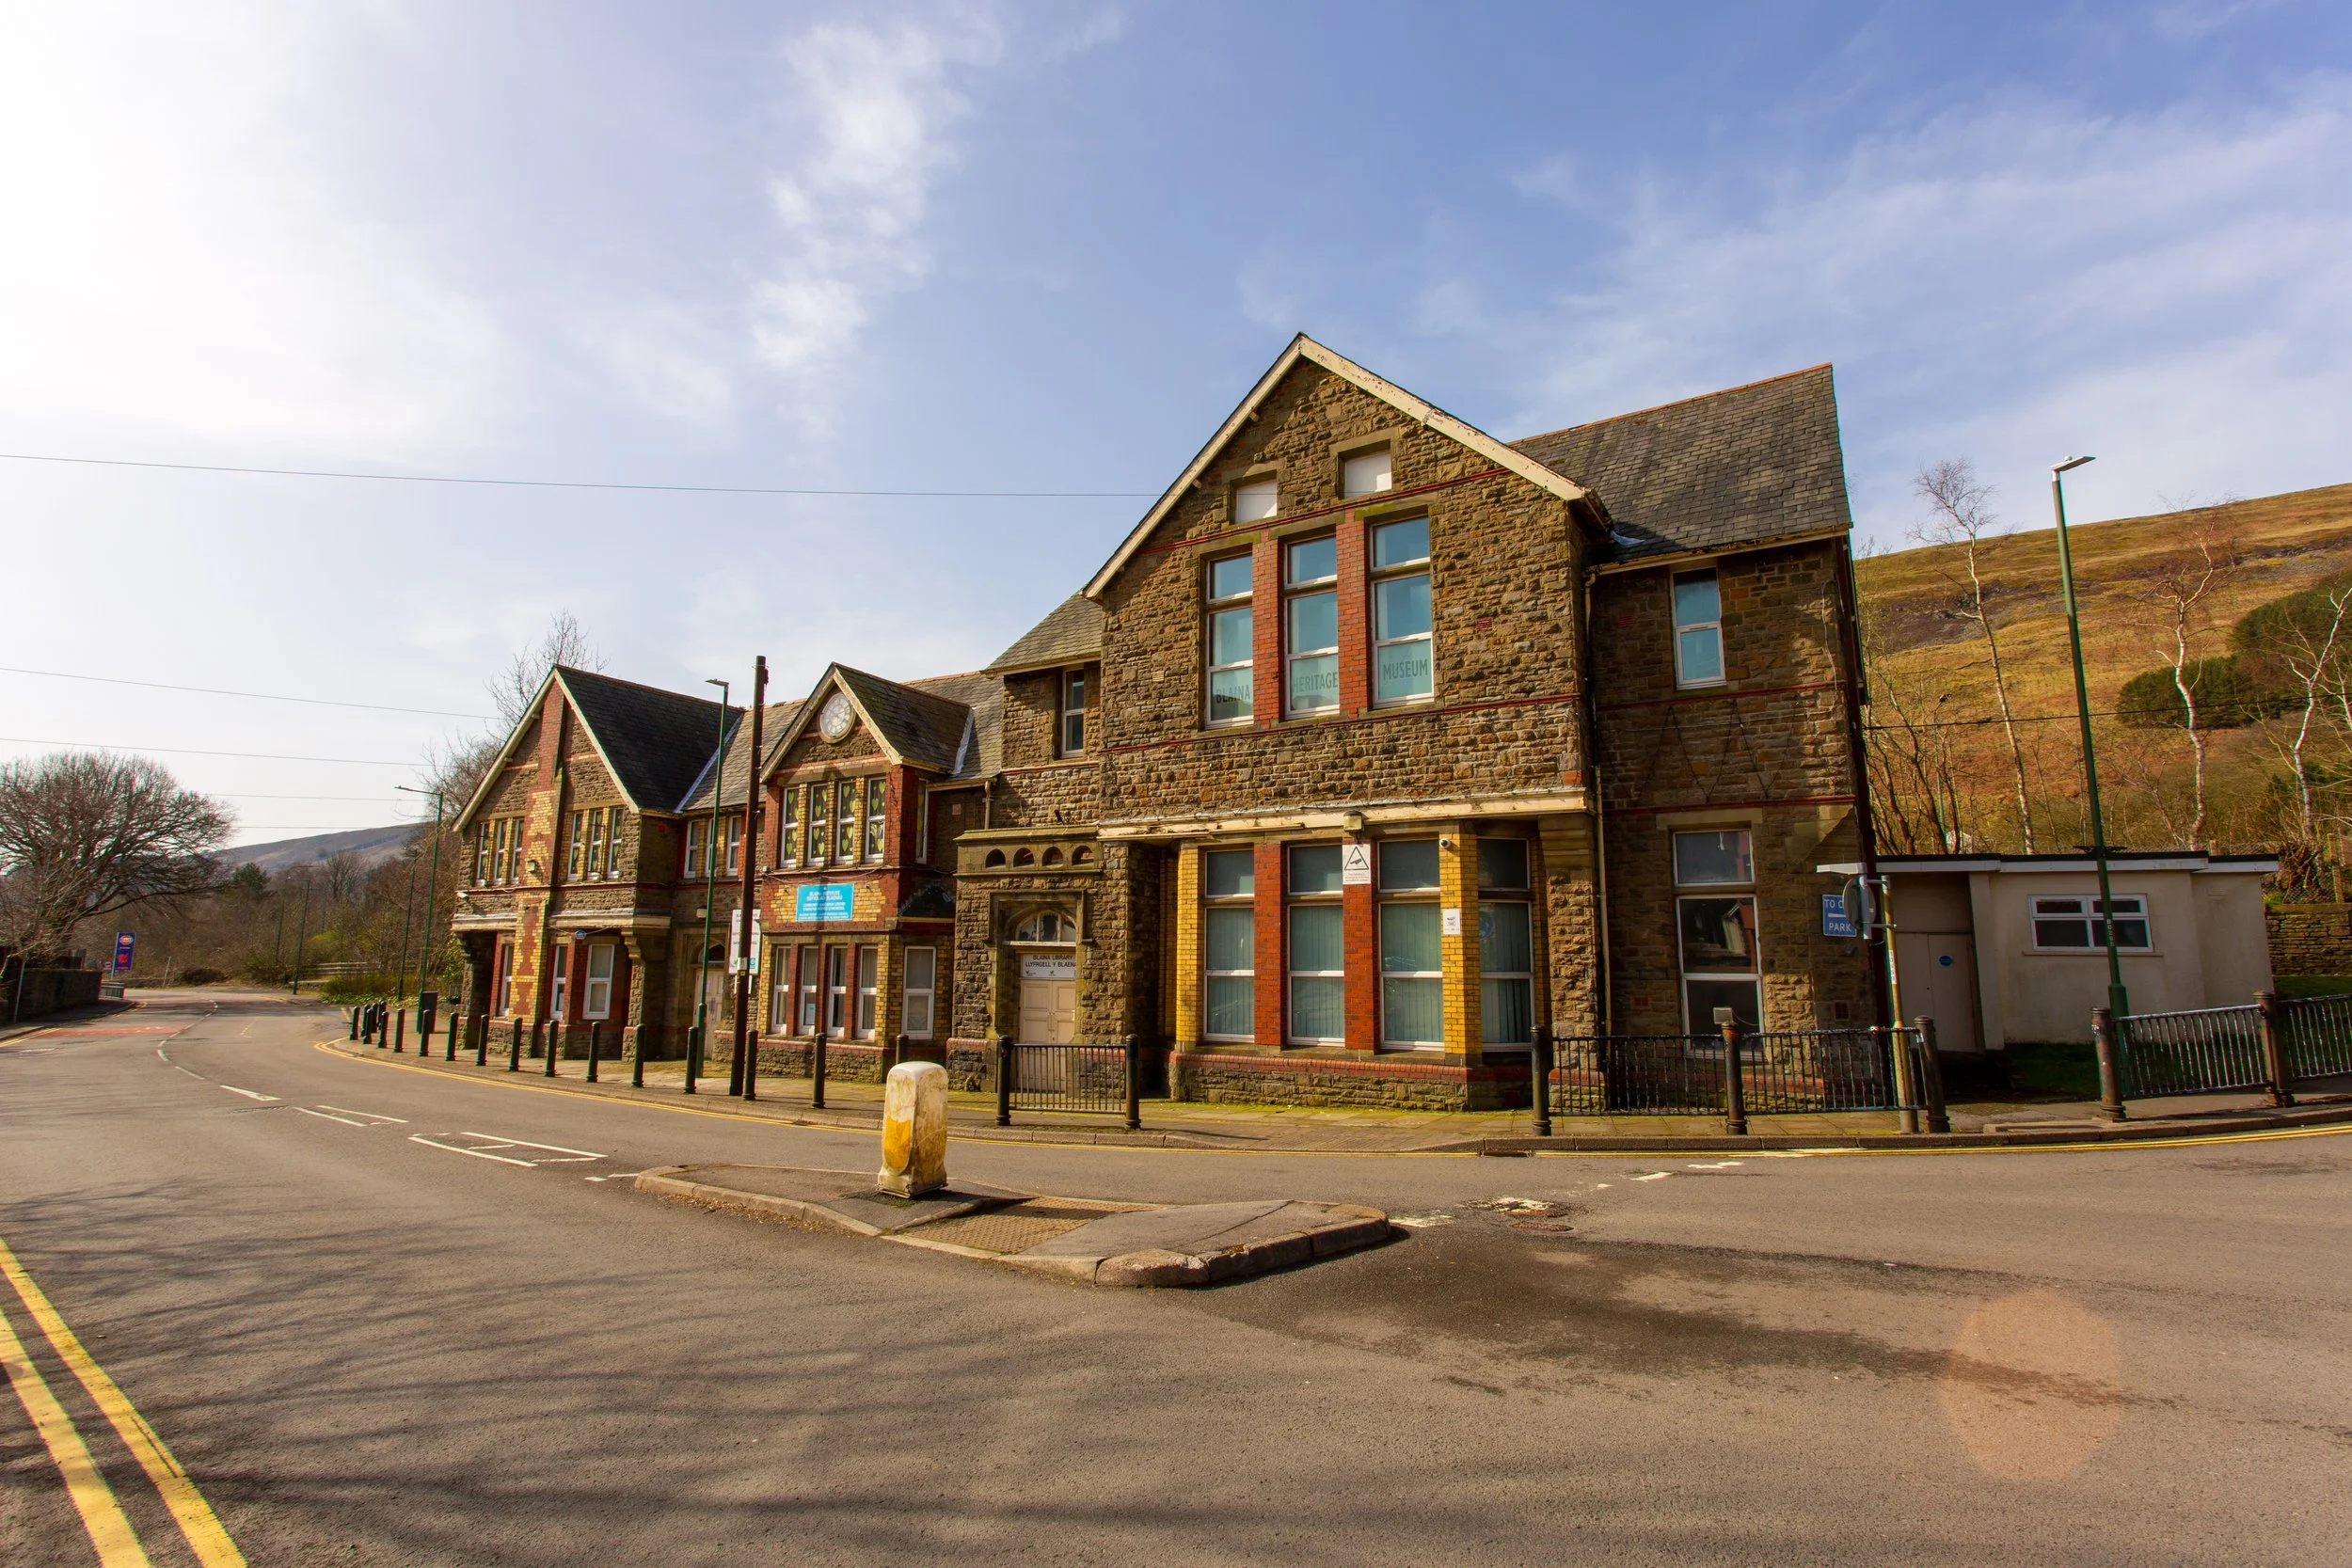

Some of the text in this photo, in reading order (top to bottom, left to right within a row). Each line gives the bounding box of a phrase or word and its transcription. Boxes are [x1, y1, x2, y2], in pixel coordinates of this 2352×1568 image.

[1216, 659, 1428, 704] BLAINA HERITAGE MUSEUM
[1824, 899, 1836, 908] TO
[1828, 923, 1851, 932] PARK
